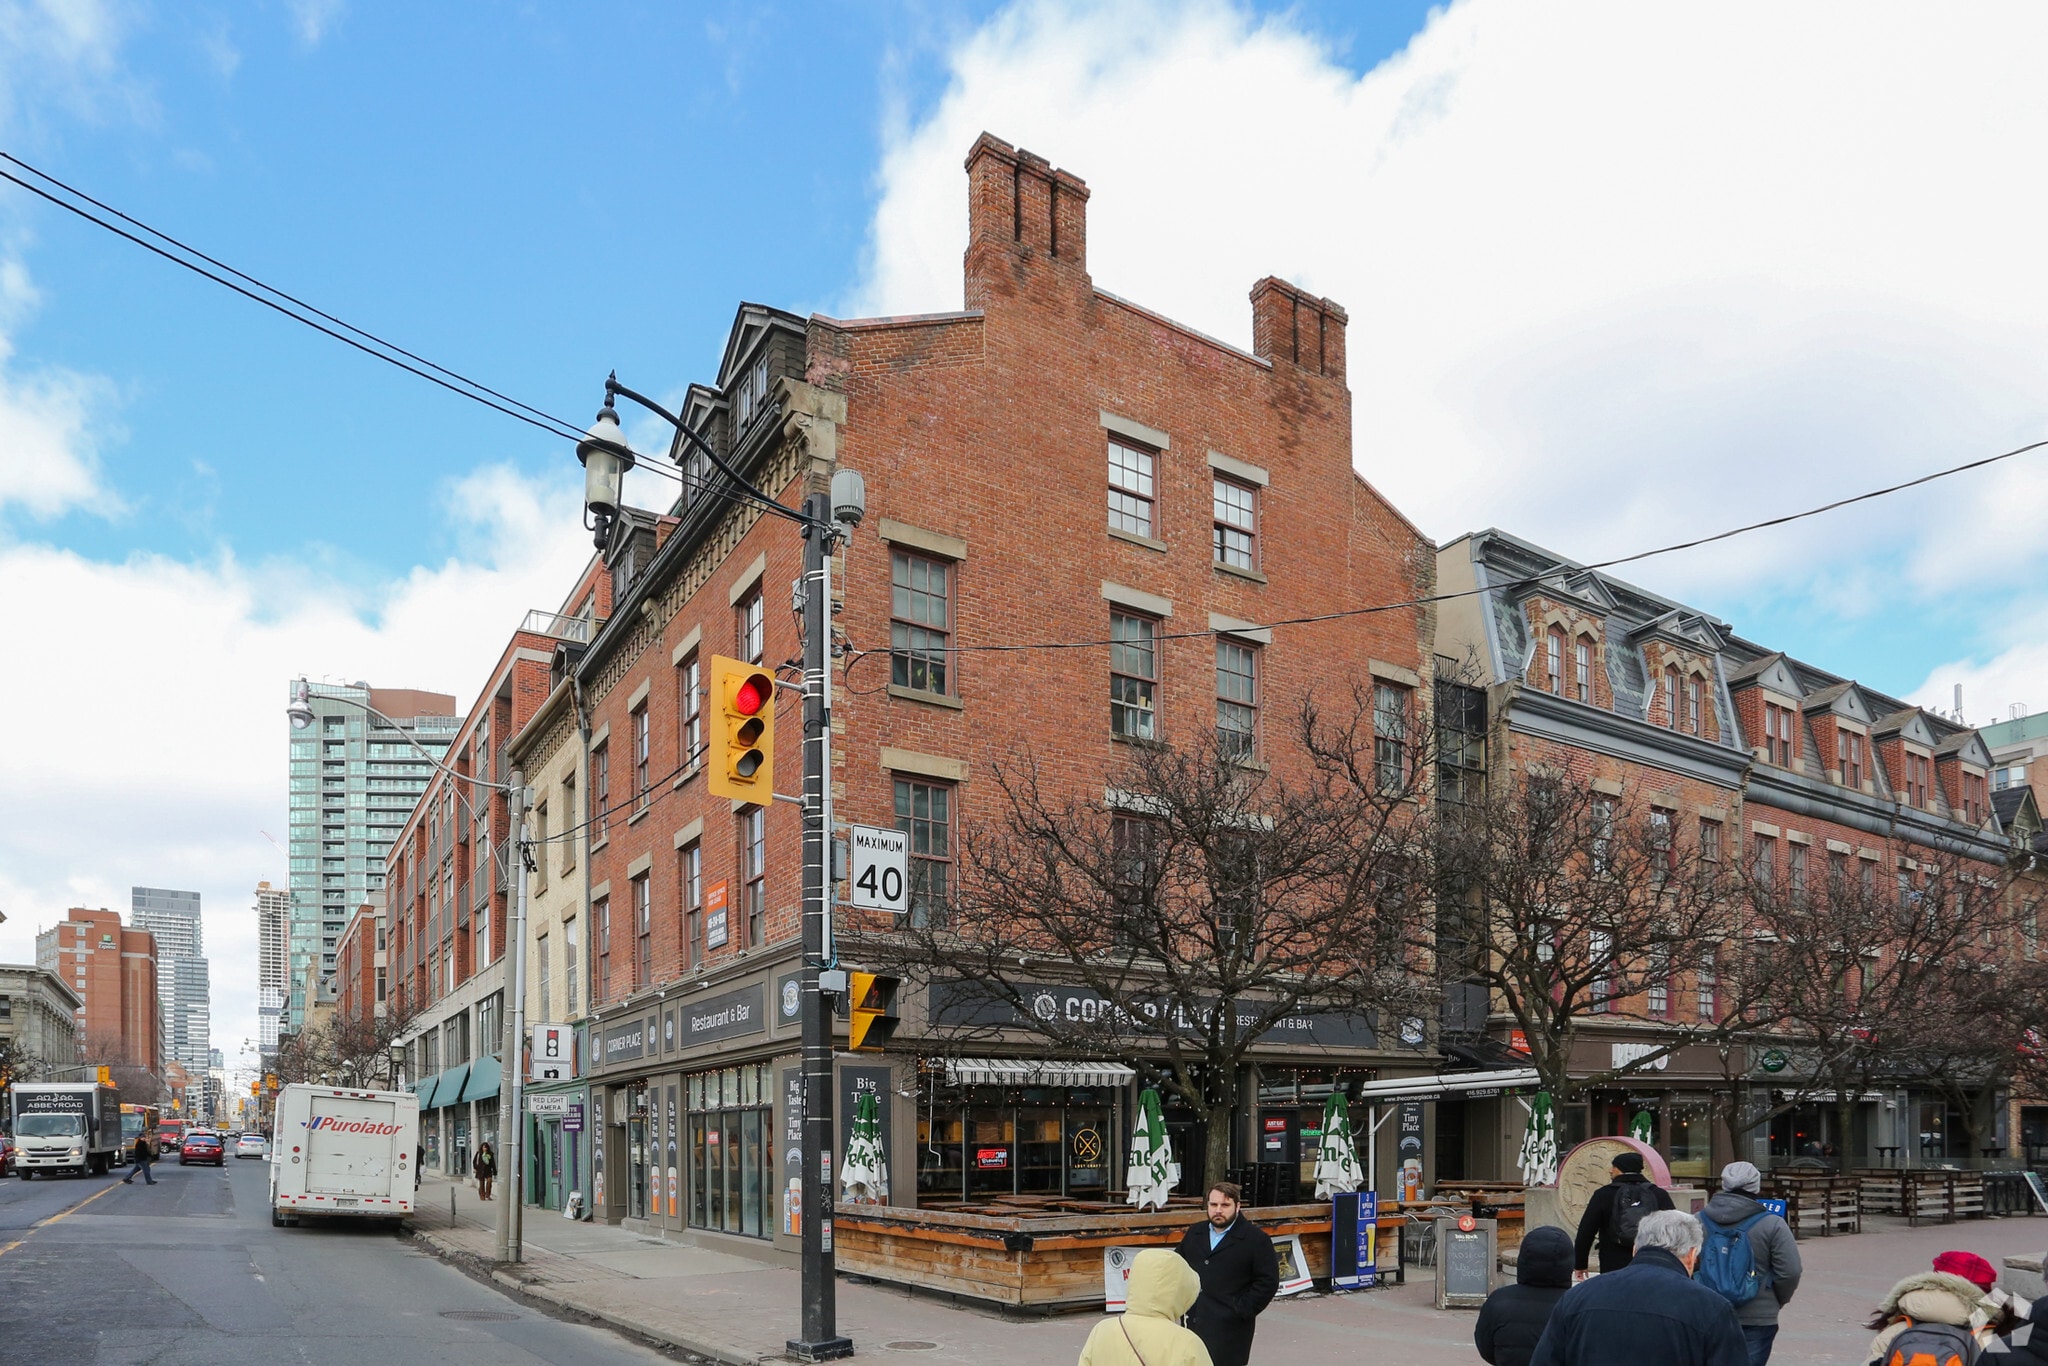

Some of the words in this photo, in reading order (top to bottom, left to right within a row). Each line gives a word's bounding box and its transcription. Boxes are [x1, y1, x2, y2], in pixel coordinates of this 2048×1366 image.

[856, 835, 903, 853] MAXIMUM
[856, 864, 903, 902] 40
[691, 1010, 729, 1033] Restaurant
[731, 1010, 736, 1022] &
[737, 1003, 750, 1022] Bar
[1297, 1019, 1313, 1030] BAR
[607, 1036, 626, 1053] CORNER
[626, 1031, 642, 1049] PLACE
[789, 1080, 800, 1095] Big
[856, 1077, 877, 1093] Big
[787, 1094, 802, 1106] Taste
[319, 1117, 403, 1135] Purolator
[788, 1117, 802, 1131] Tiny
[1403, 1113, 1419, 1125] Tiny
[787, 1129, 802, 1140] Place
[1402, 1123, 1420, 1132] Place
